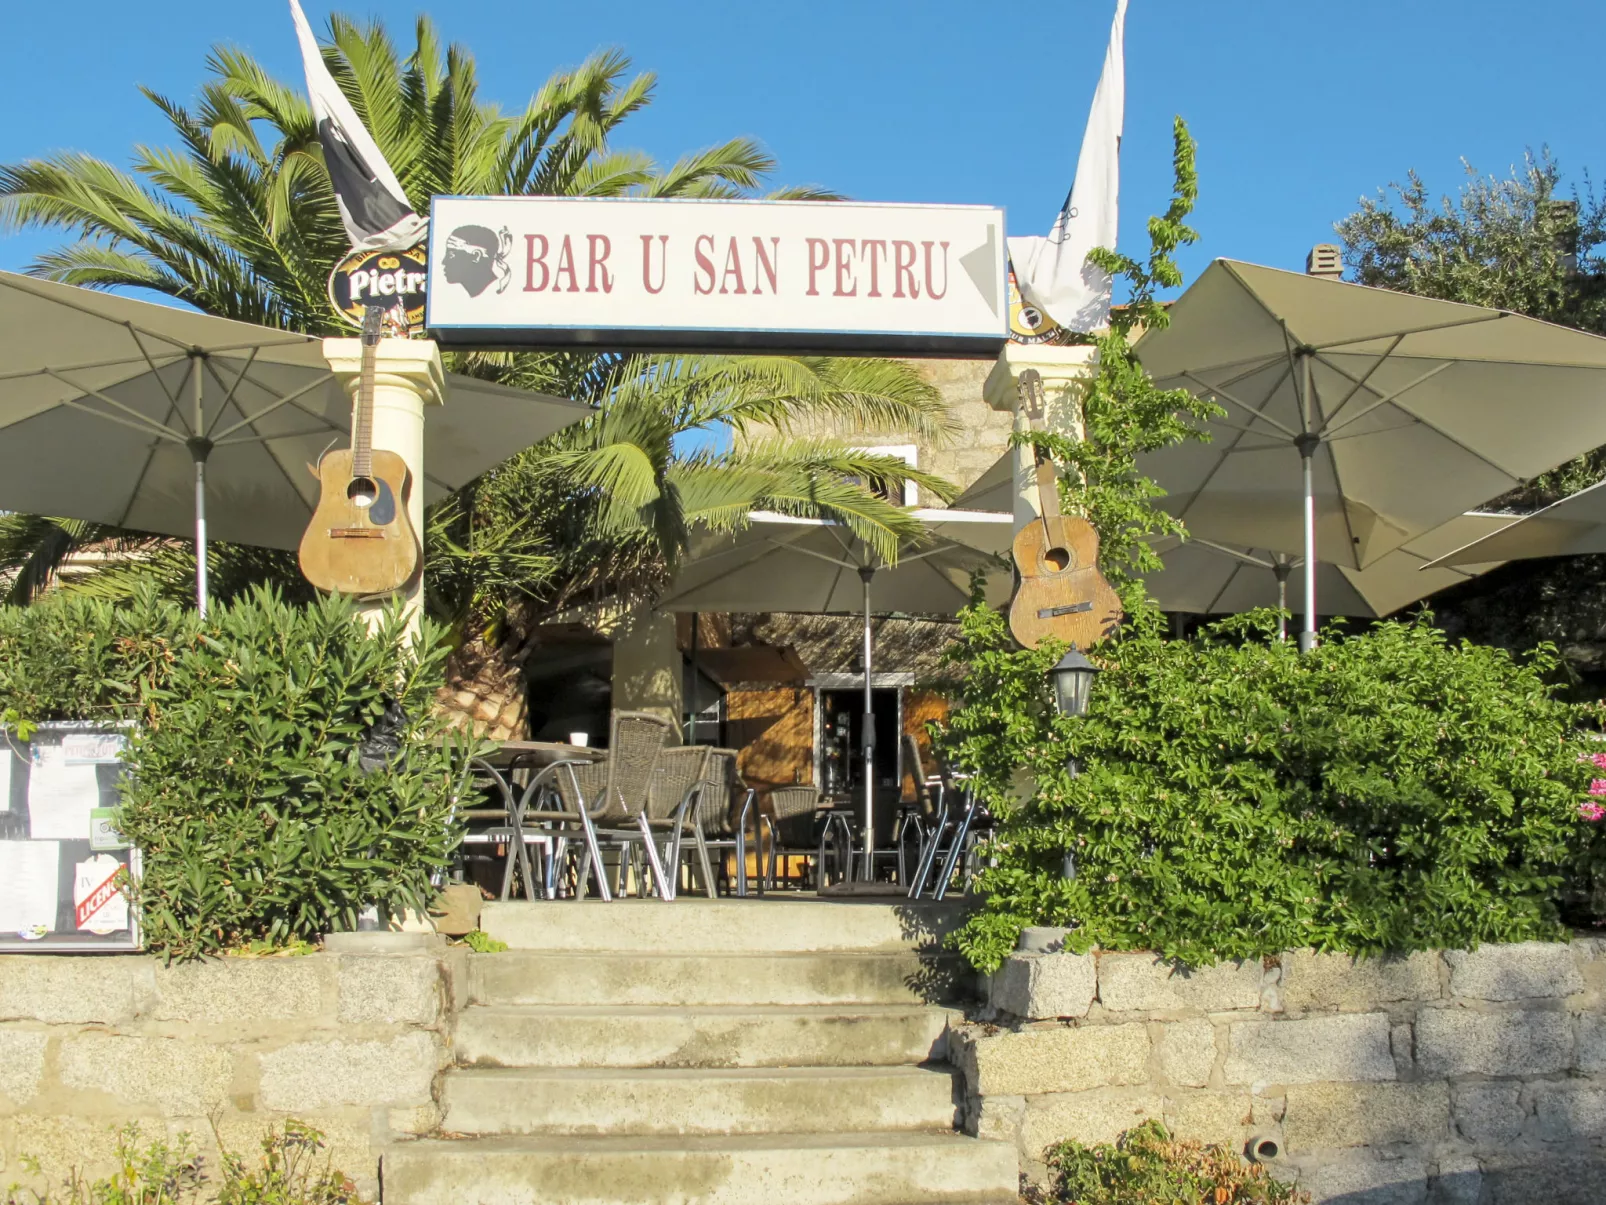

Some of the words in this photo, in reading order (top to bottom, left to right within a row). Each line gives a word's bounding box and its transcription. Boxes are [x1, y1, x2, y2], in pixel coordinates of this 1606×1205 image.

[523, 234, 615, 294] BAR
[639, 235, 669, 295] U
[694, 234, 781, 295] SAN
[805, 237, 951, 301] PETRU
